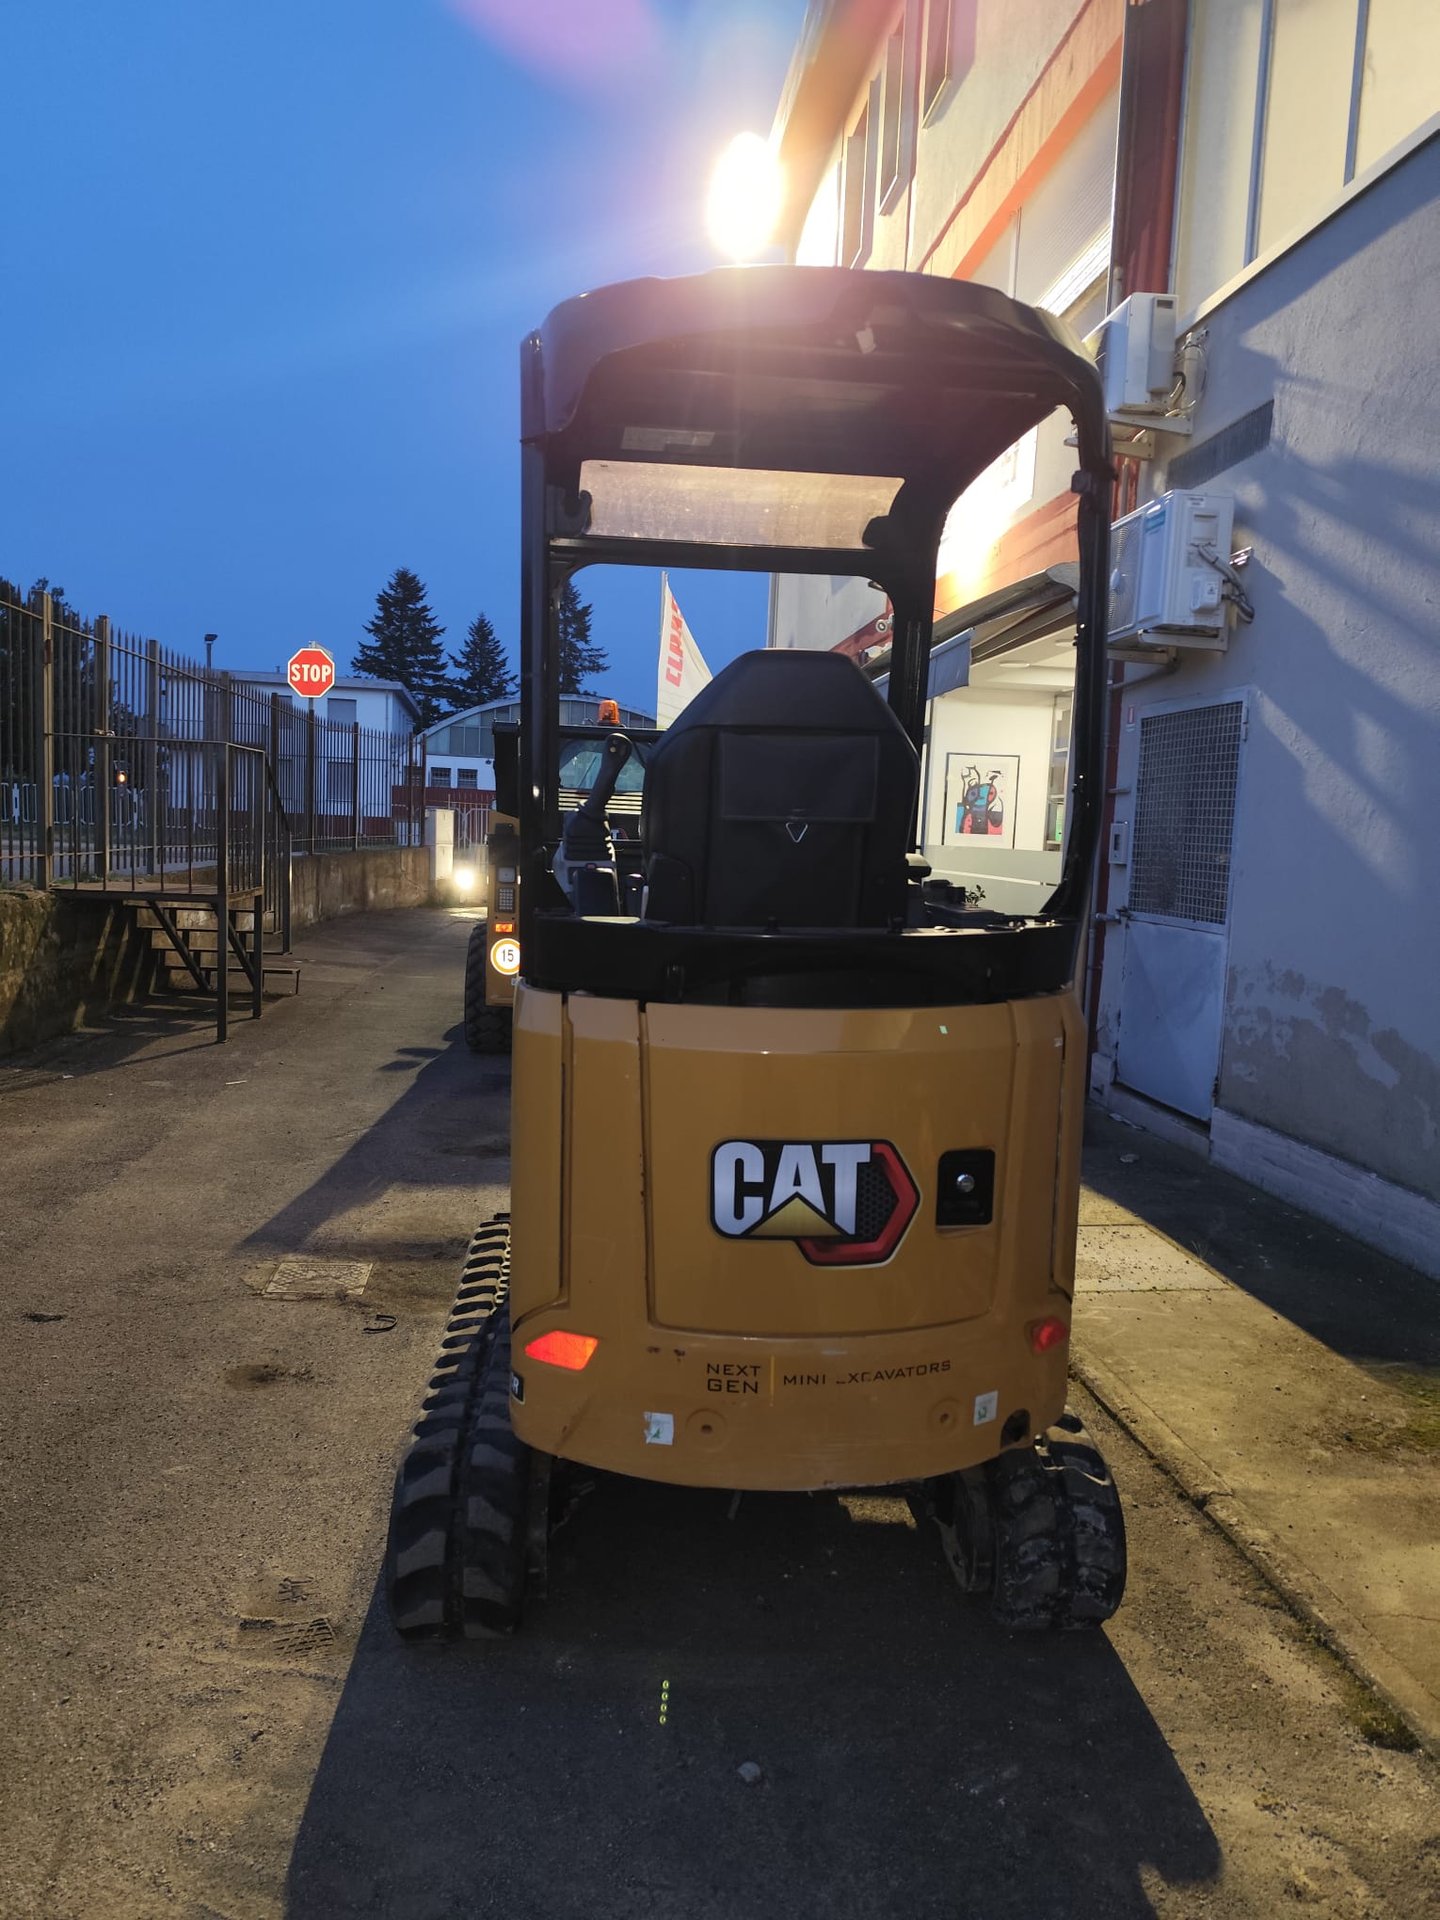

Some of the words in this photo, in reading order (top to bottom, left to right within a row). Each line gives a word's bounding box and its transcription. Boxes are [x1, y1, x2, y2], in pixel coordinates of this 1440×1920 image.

[291, 663, 332, 683] STOP
[502, 949, 514, 962] 15
[714, 1141, 871, 1235] CAT
[706, 1363, 761, 1377] NEXT
[783, 1374, 826, 1386] MINI
[836, 1360, 951, 1385] XCAVATORS
[707, 1379, 758, 1394] GEN
